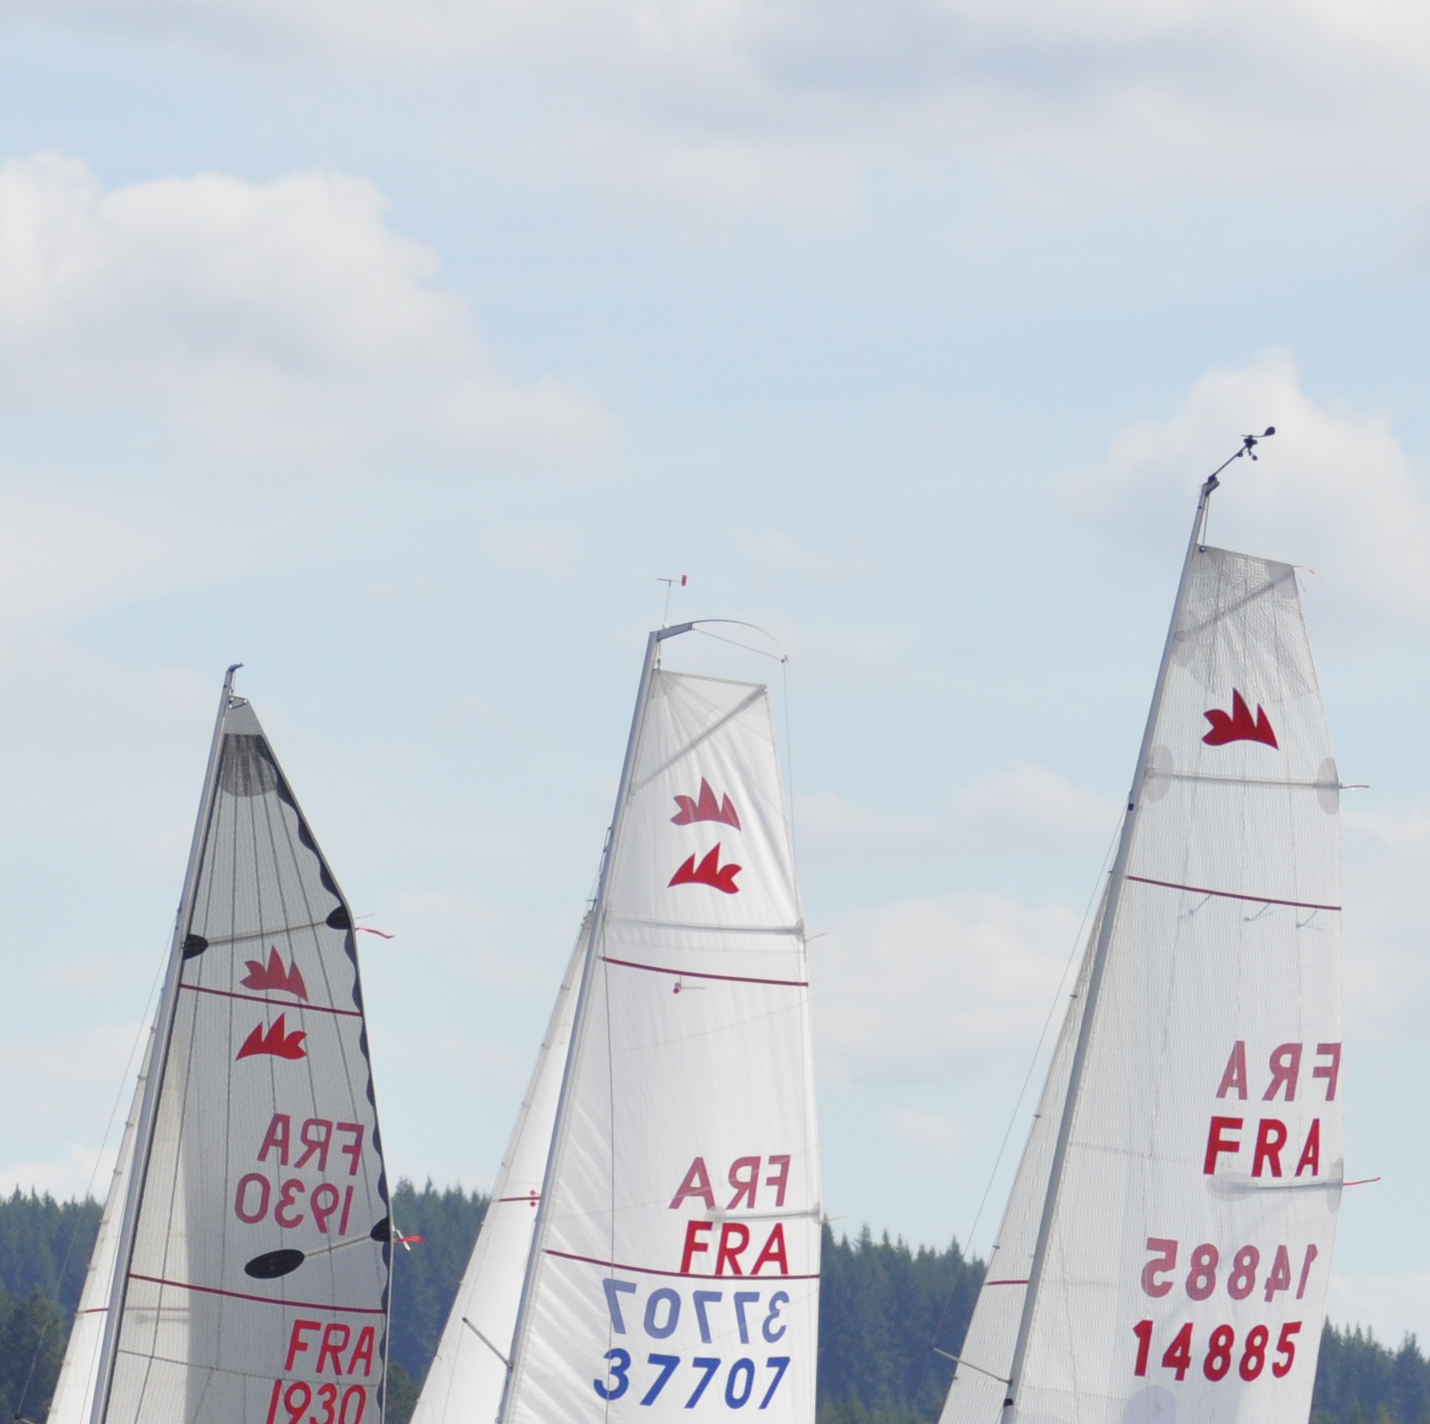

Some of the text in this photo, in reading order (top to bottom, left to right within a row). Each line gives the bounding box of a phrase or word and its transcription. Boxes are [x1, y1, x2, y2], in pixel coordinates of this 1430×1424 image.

[1203, 1115, 1321, 1178] FRA
[680, 1219, 790, 1276] FRA
[284, 1318, 376, 1377] FRA
[592, 1347, 791, 1411] 37707
[1132, 1319, 1303, 1382] 14885
